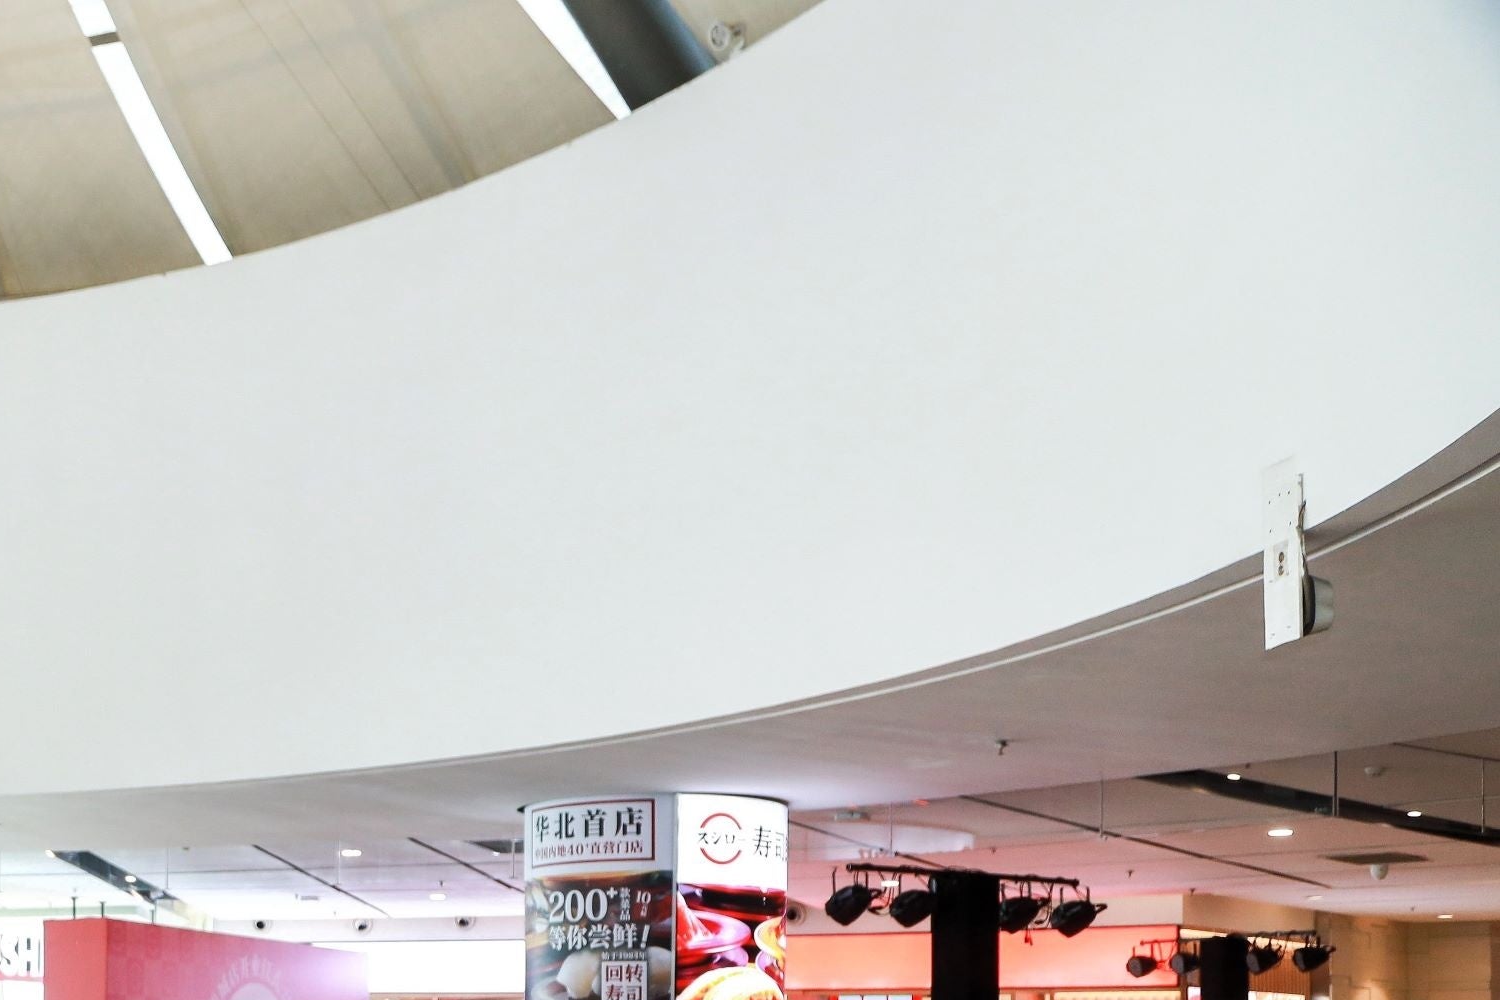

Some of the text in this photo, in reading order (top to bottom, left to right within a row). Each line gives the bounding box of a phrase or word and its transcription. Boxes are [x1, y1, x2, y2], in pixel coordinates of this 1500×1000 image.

[535, 806, 643, 842] 华北首店
[752, 825, 788, 861] 寿司
[606, 964, 643, 983] 回转
